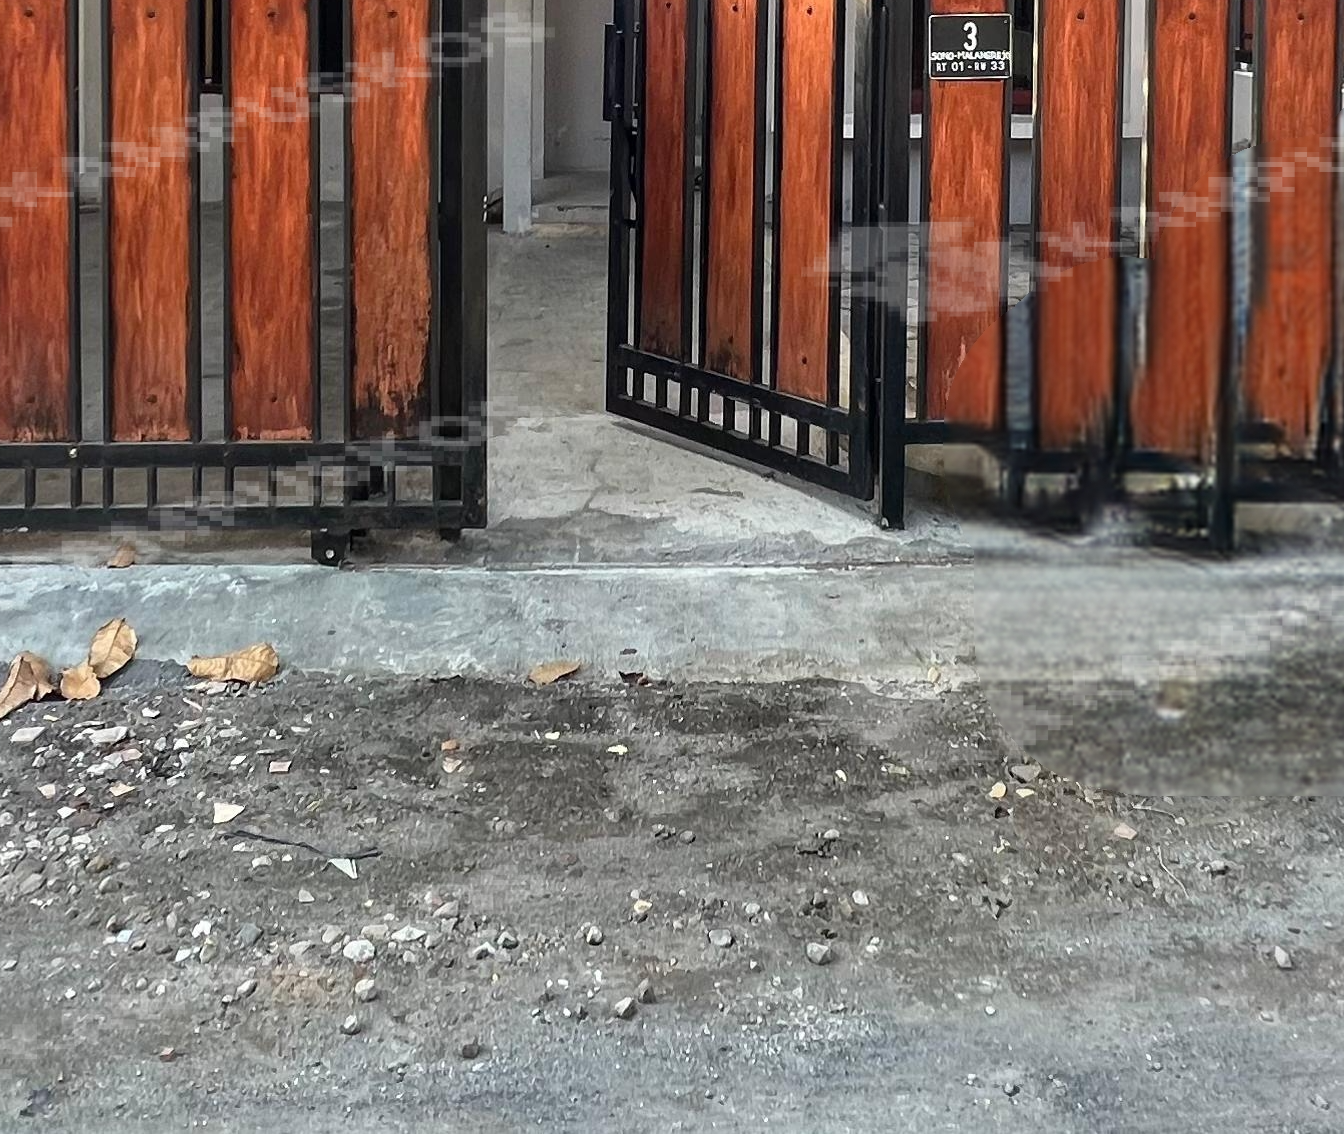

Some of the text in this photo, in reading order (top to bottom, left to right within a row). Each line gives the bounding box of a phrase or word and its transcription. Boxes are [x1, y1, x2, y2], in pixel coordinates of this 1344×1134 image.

[963, 22, 976, 50] 3
[936, 63, 946, 72] RT
[951, 61, 963, 72] 01
[974, 61, 986, 72] RW
[990, 60, 1005, 71] 33
